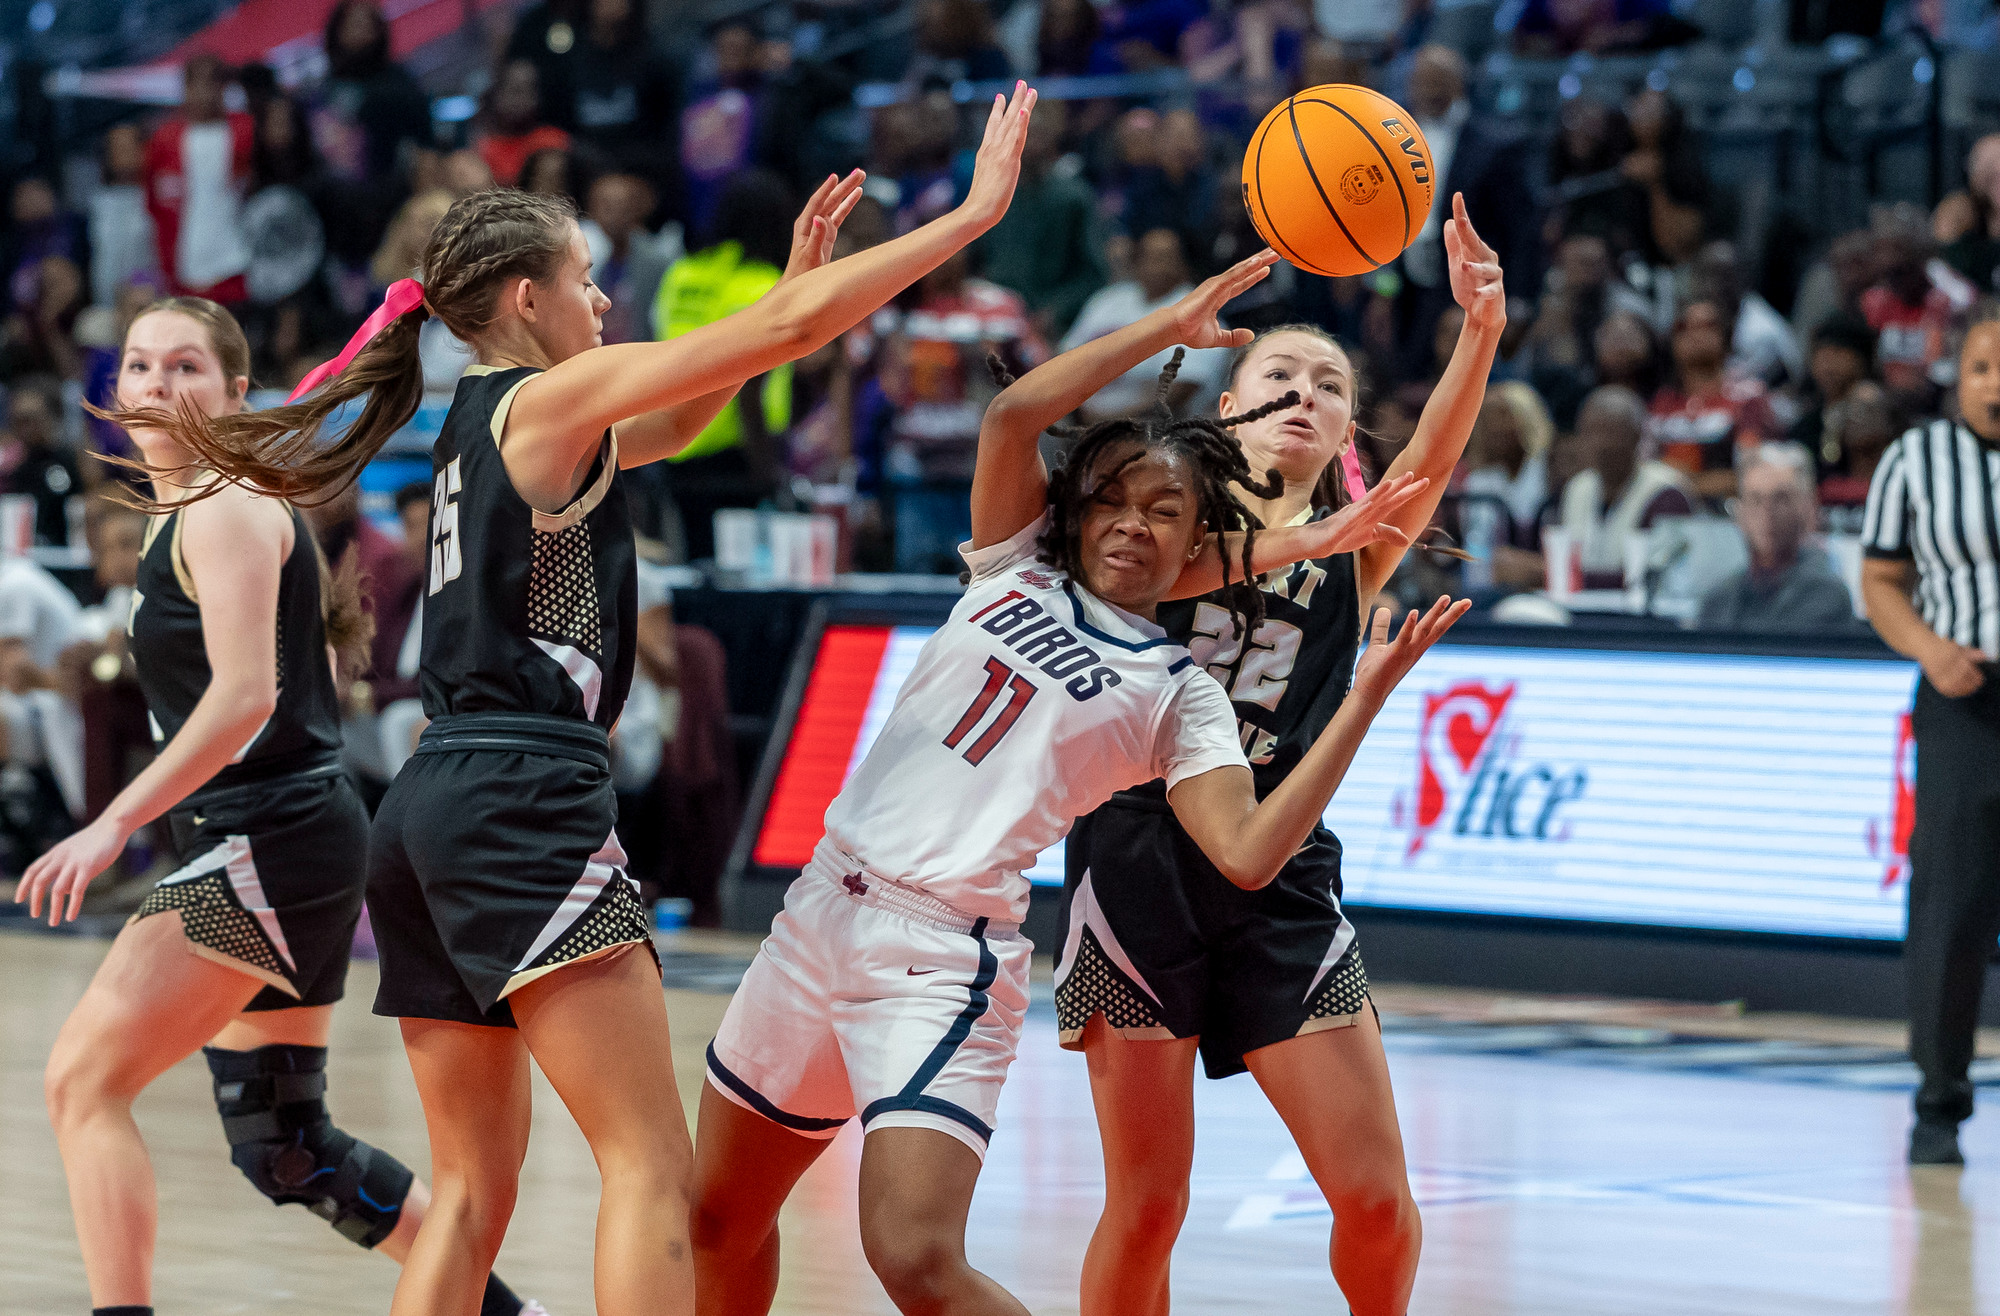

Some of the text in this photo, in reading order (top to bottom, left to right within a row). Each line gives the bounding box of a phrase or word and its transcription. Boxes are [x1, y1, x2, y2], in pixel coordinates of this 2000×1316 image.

[1380, 117, 1430, 185] EVO
[428, 453, 462, 597] 25
[967, 589, 1122, 702] TBIRDS
[1188, 601, 1303, 712] 22
[941, 654, 1039, 768] 11
